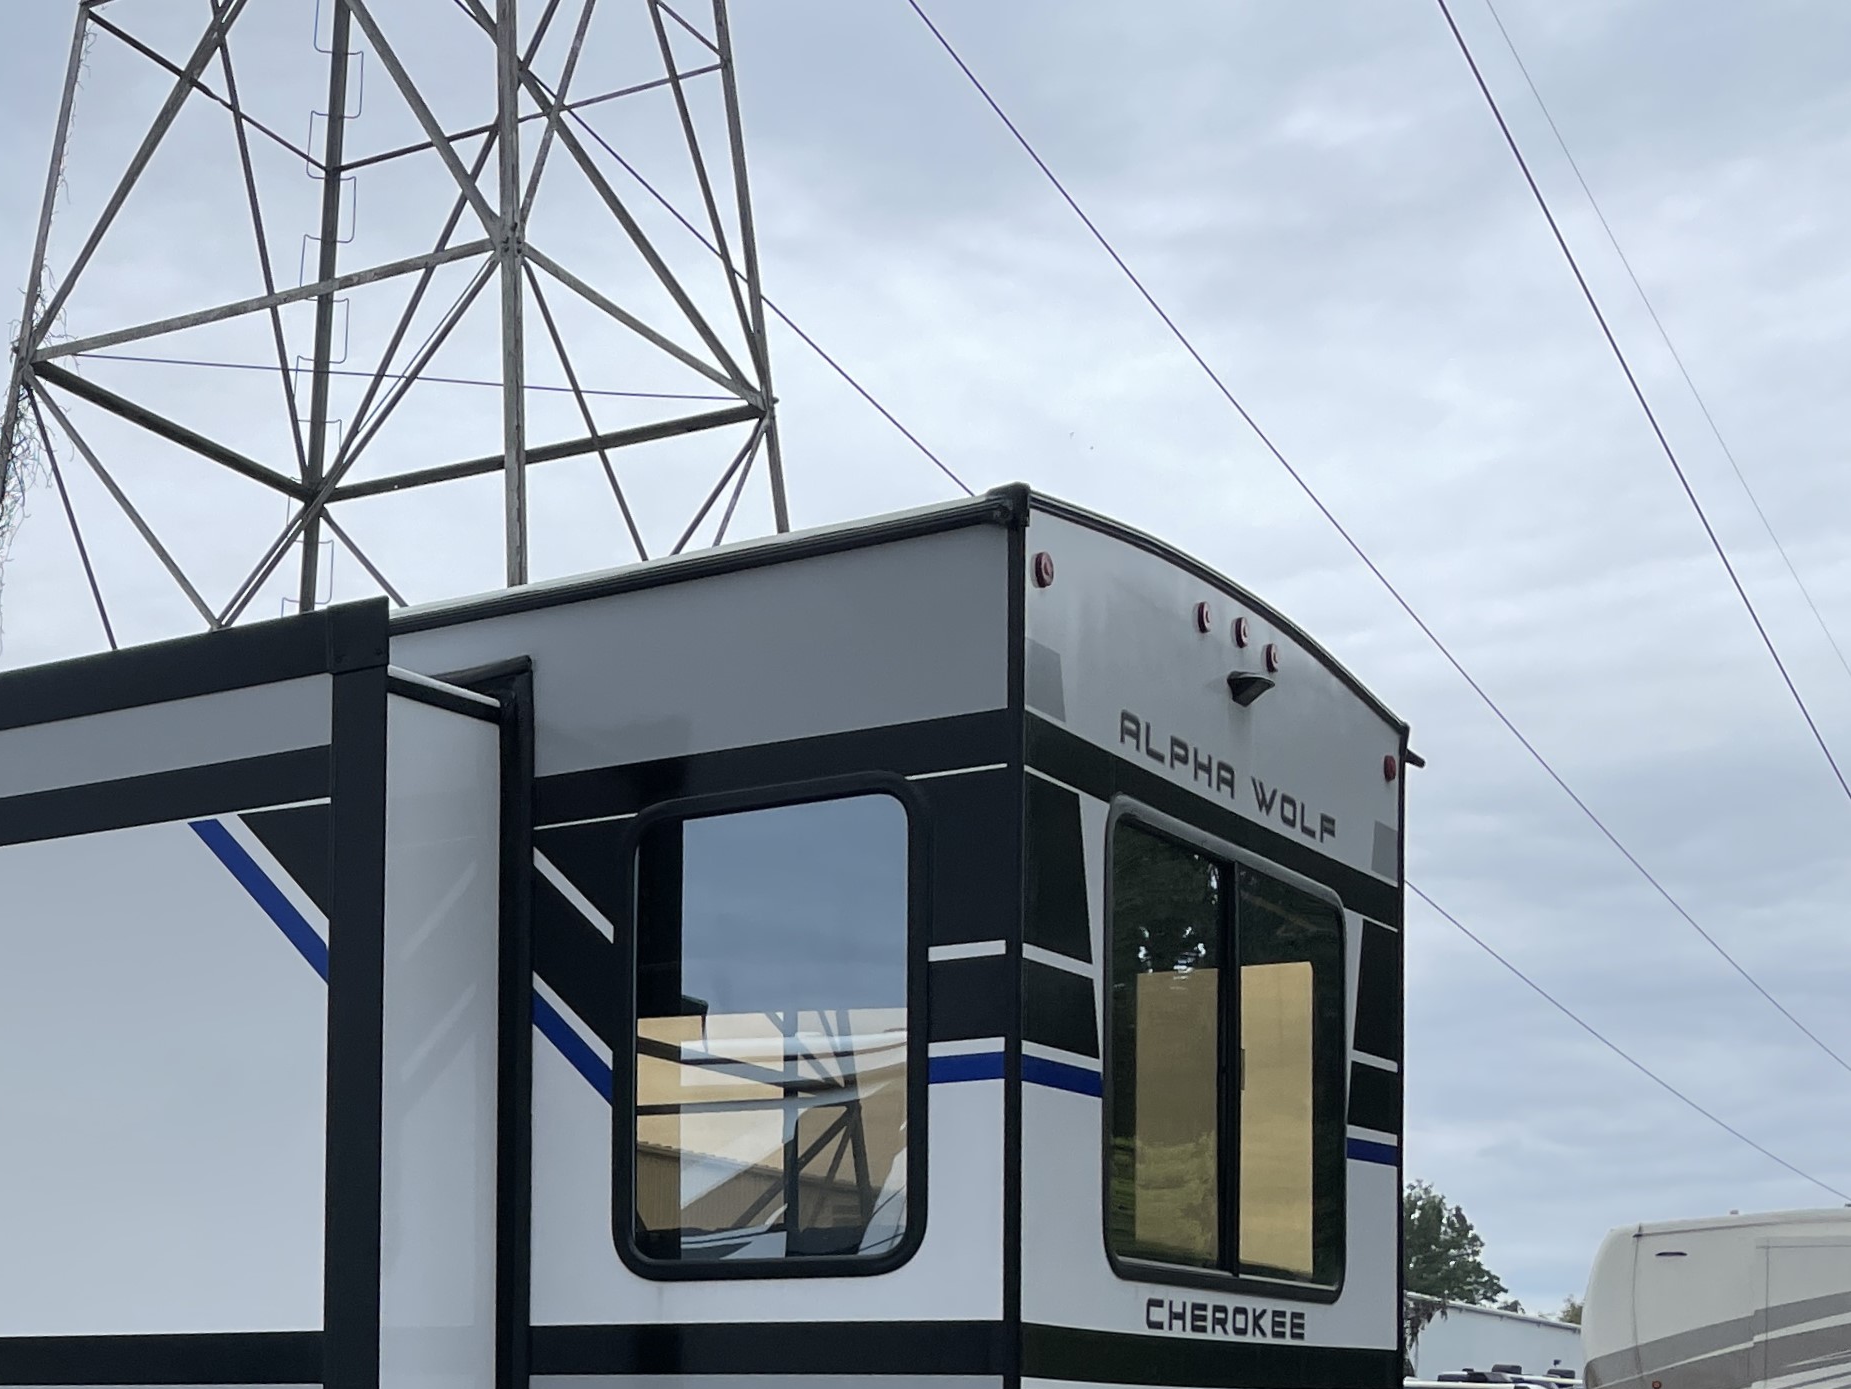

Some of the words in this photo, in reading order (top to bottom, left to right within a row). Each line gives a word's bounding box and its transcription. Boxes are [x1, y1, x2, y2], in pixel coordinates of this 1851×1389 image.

[1119, 709, 1235, 800] ALPHA
[1250, 775, 1336, 844] WOLF
[1145, 1297, 1306, 1341] CHEROKEE
